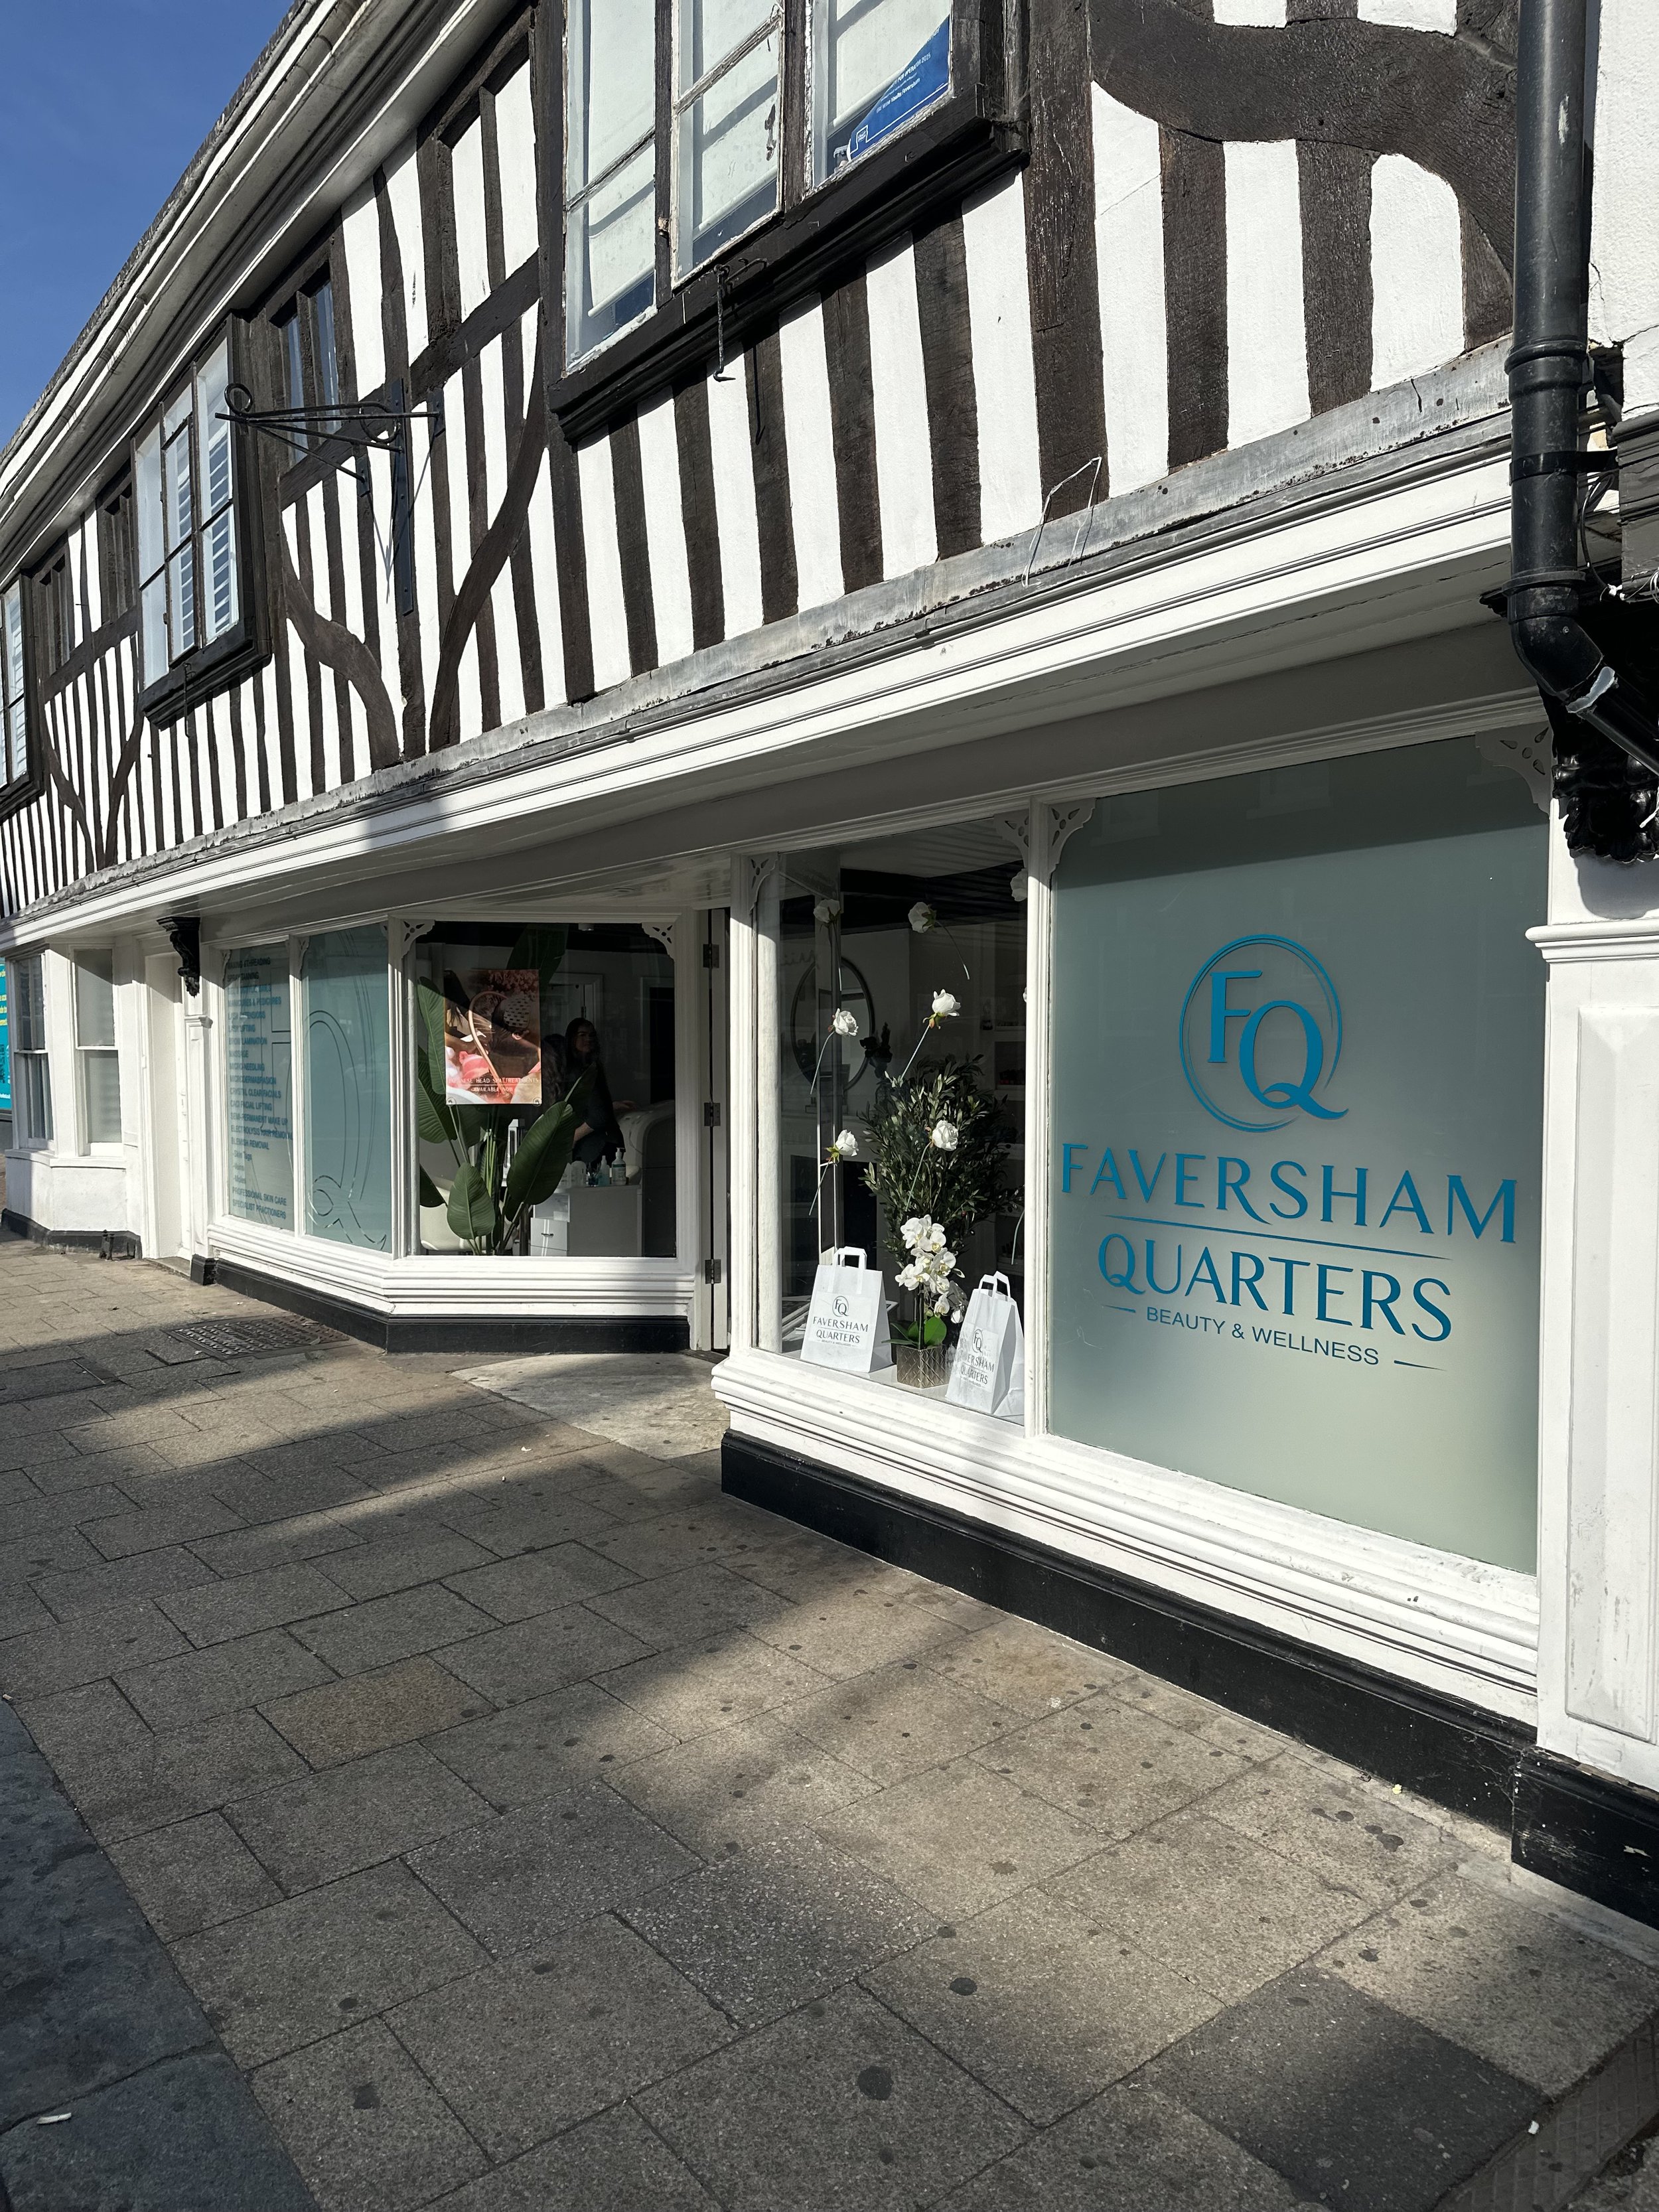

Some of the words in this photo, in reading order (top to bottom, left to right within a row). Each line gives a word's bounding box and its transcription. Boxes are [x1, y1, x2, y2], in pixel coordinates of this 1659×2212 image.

[241, 972, 259, 980] TANNING
[1207, 970, 1349, 1120] FQ
[230, 1087, 248, 1096] CRYSTAL
[248, 1088, 263, 1097] CLEAR
[263, 1089, 281, 1099] FACIALS
[241, 1100, 255, 1110] FACIAL
[255, 1102, 273, 1112] LIFTING
[250, 1140, 269, 1150] REMOVAL
[232, 1186, 263, 1201] PROFESSIONAL
[263, 1193, 274, 1203] SKIN
[274, 1196, 287, 1207] CARE
[1061, 1143, 1518, 1244] FAVERSHAM
[232, 1199, 255, 1211] SPECIALIST
[1098, 1233, 1452, 1343] QUARTERS
[834, 1299, 849, 1316] FQ
[813, 1316, 868, 1332] FAVERSHAM
[816, 1329, 860, 1344] QUARTERS
[974, 1332, 982, 1353] FQ
[1145, 1306, 1226, 1336] BEAUTY
[1232, 1323, 1245, 1339] &
[1252, 1326, 1380, 1367] WELLNESS
[961, 1364, 988, 1384] QUARTERS
